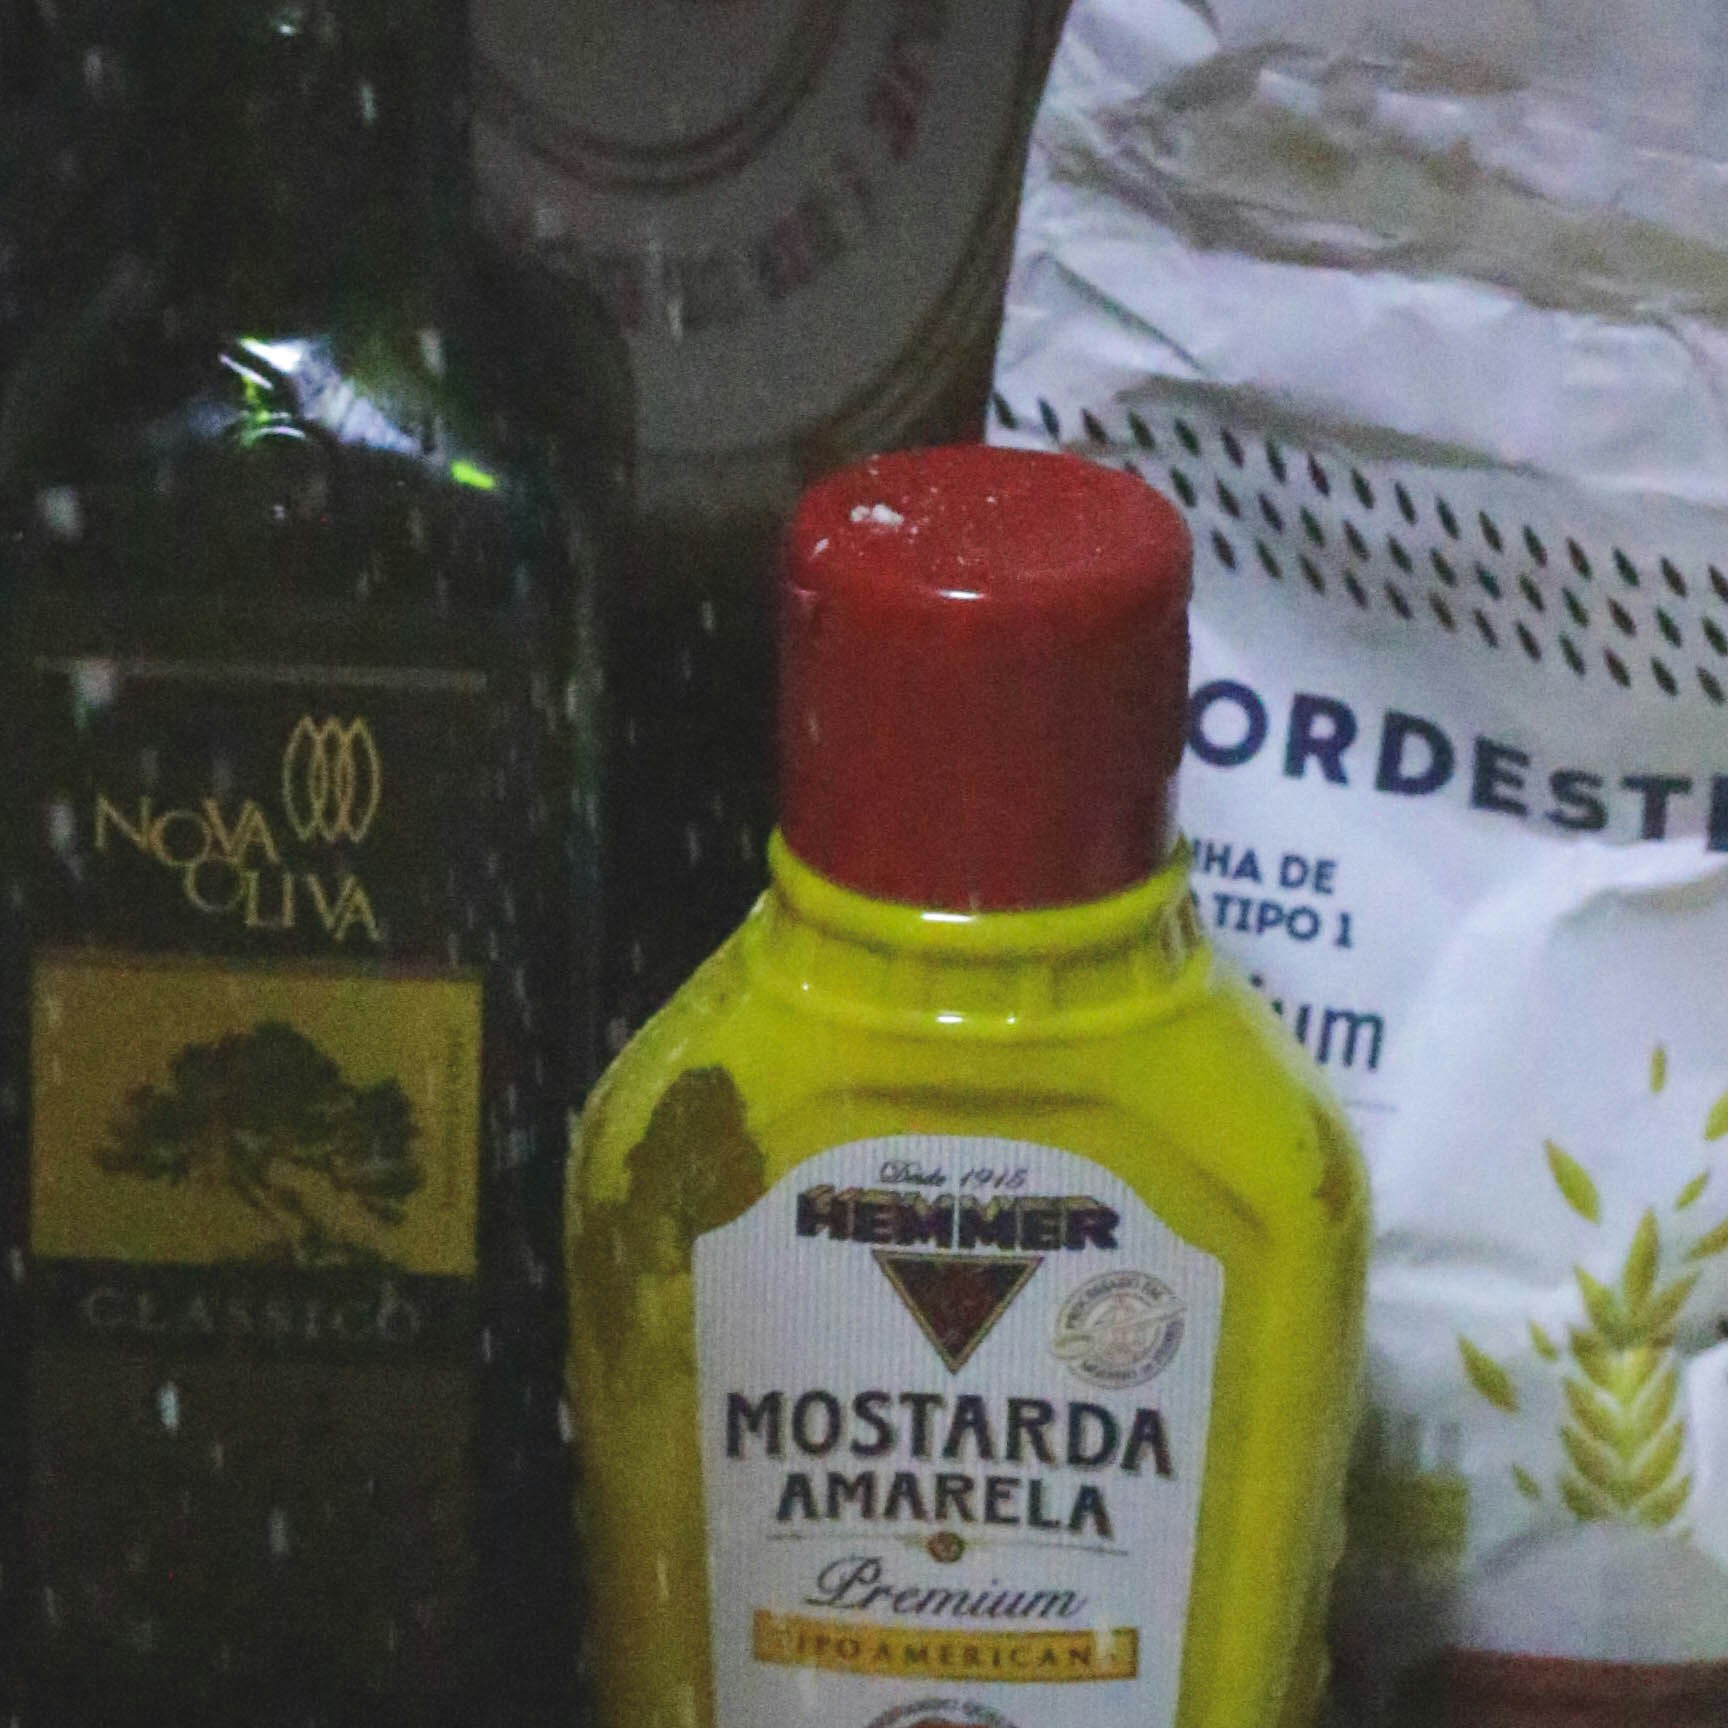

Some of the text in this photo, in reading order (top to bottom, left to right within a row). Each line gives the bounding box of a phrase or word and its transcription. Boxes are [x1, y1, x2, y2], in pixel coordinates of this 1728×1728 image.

[1187, 678, 1728, 852] ORDEST
[94, 795, 284, 868] NOVA
[183, 857, 383, 942] OLIVA
[1279, 853, 1337, 896] DE
[1214, 894, 1354, 949] TIPO 1
[796, 1183, 1120, 1251] HEMMER
[727, 1391, 1174, 1480] MOSTARDA
[776, 1472, 1115, 1540] AMARELA
[804, 1555, 1089, 1621] Premium
[777, 1627, 1118, 1670] IPO AMERICAN
